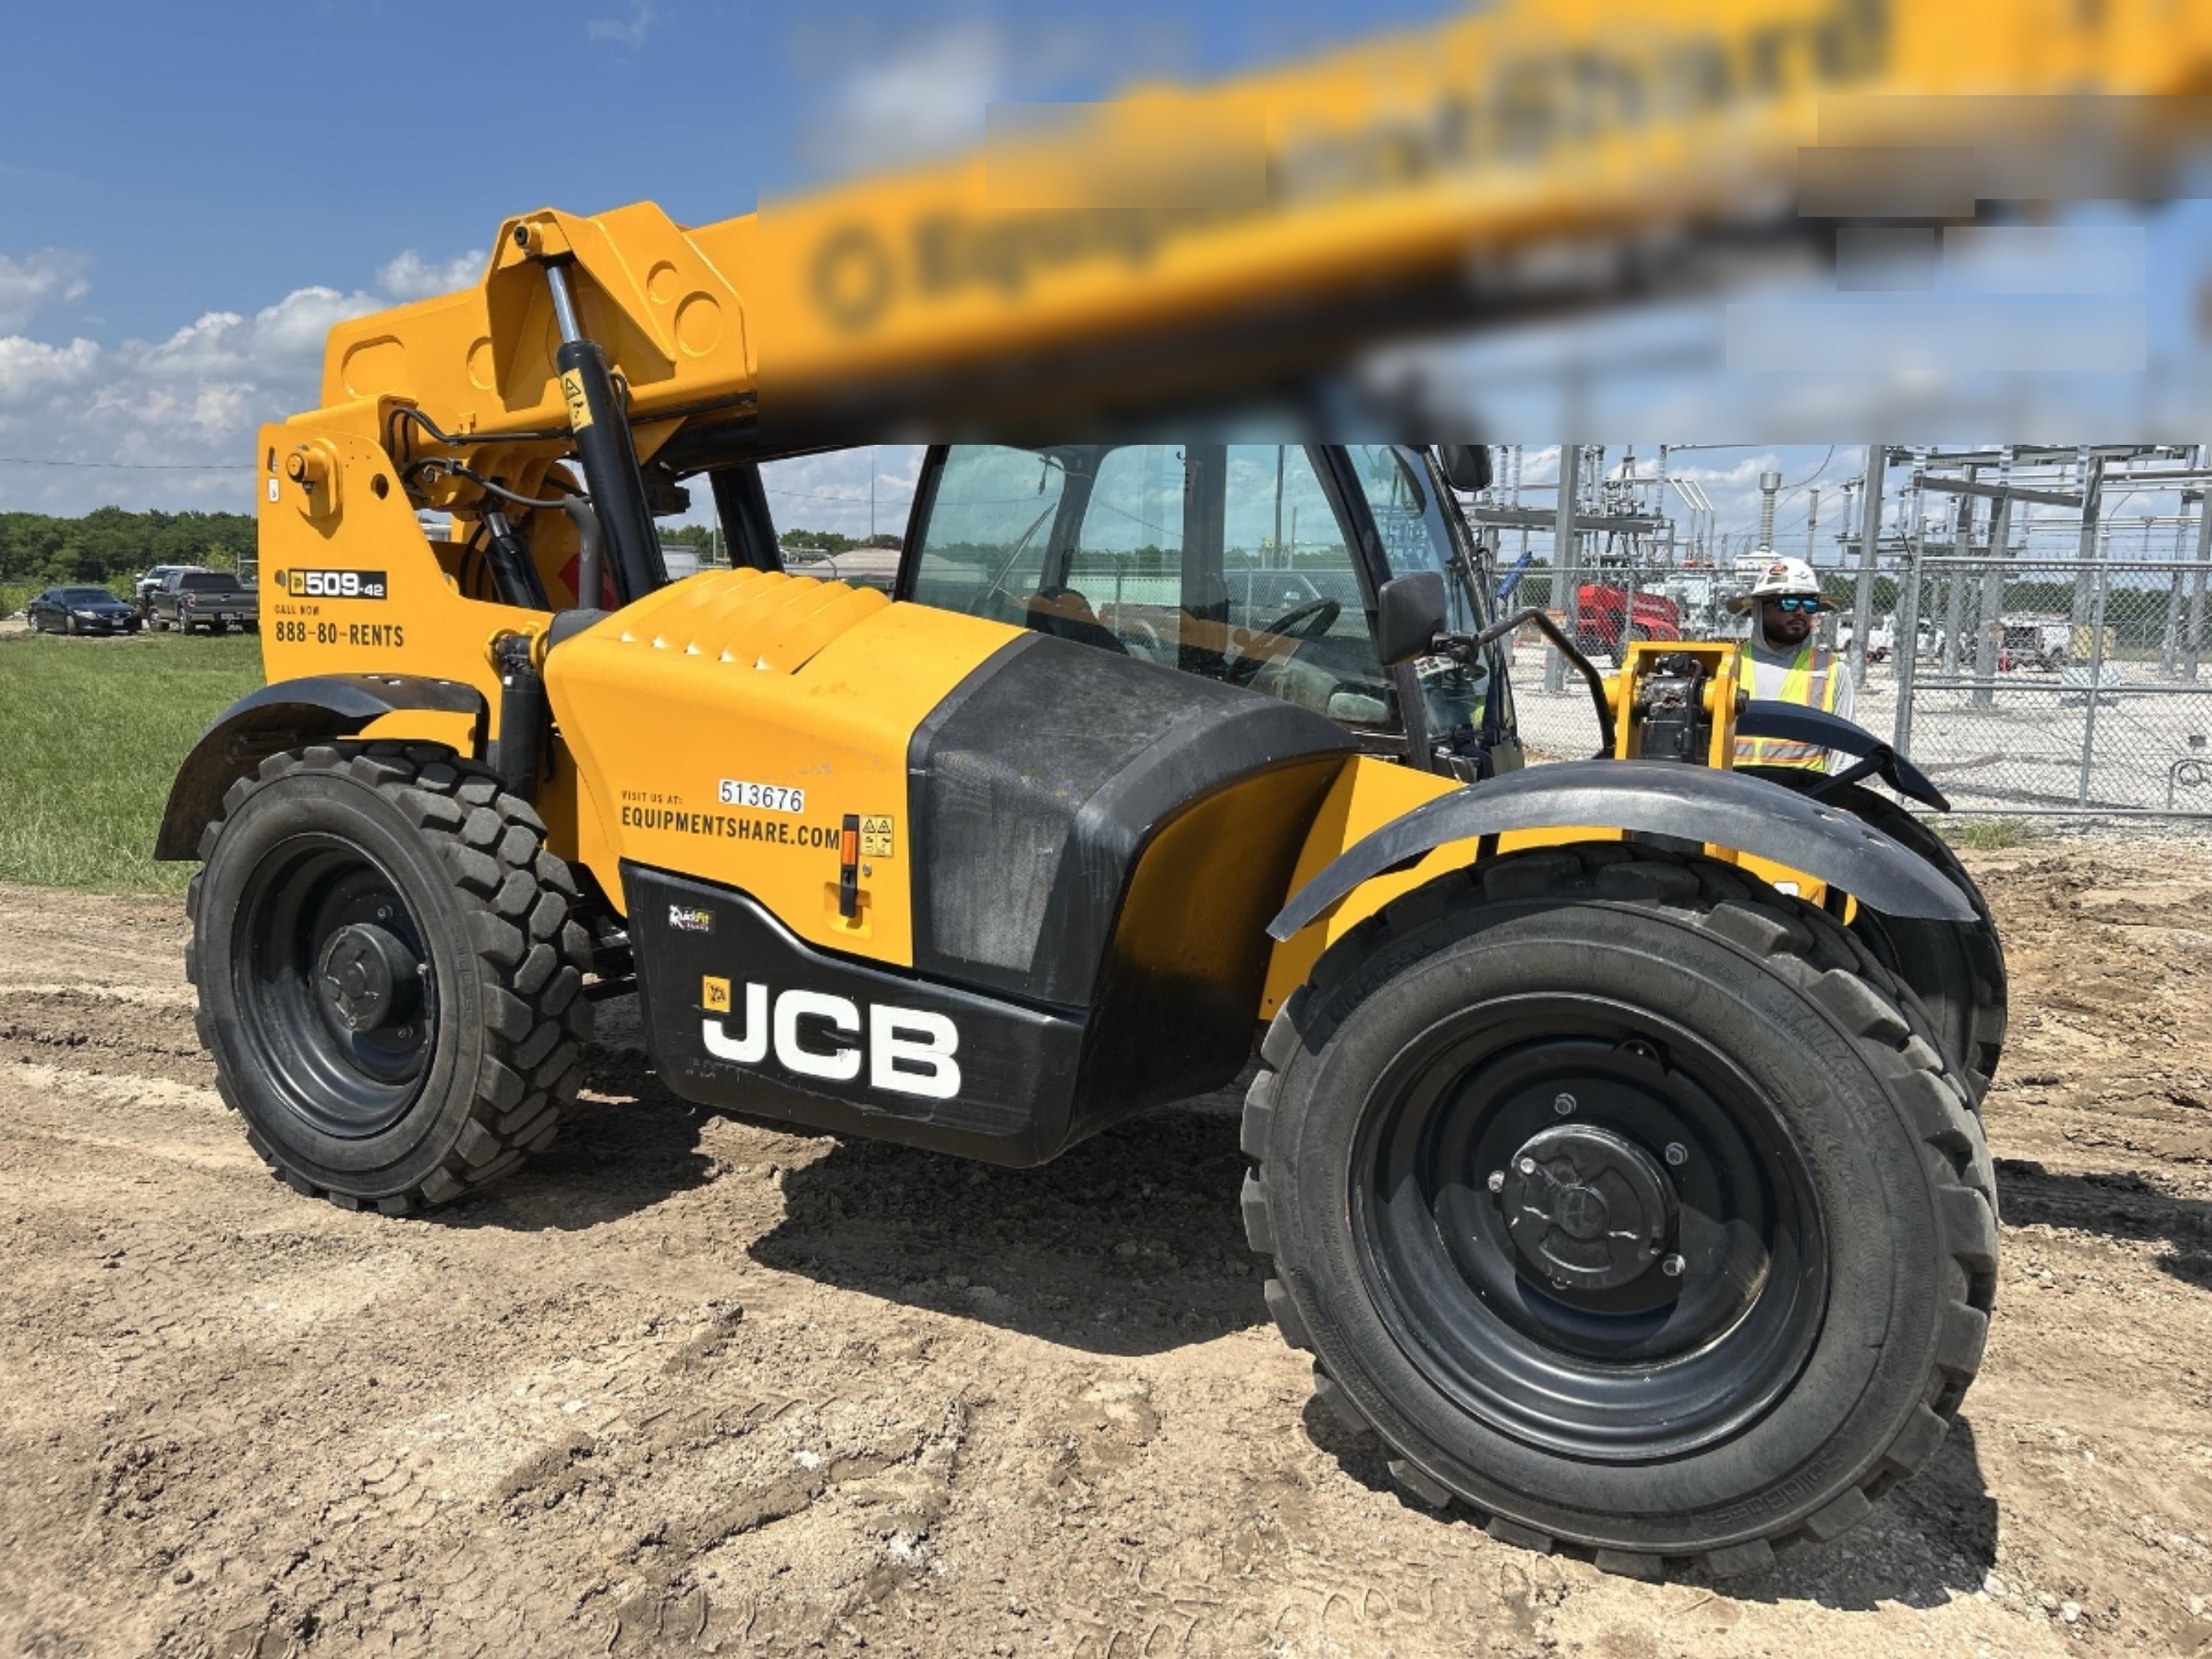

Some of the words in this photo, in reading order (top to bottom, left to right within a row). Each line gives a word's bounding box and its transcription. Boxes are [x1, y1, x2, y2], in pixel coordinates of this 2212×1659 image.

[306, 572, 385, 597] 509-42
[275, 604, 296, 615] CALL
[300, 606, 320, 616] NOW
[276, 621, 404, 648] 888-80-RENTS
[621, 790, 647, 803] VISIT
[651, 793, 664, 804] US
[667, 795, 683, 806] AT:
[721, 781, 803, 812] 513676
[622, 806, 840, 850] EQUIPMENTSHARE.COM
[703, 982, 960, 1099] JCB
